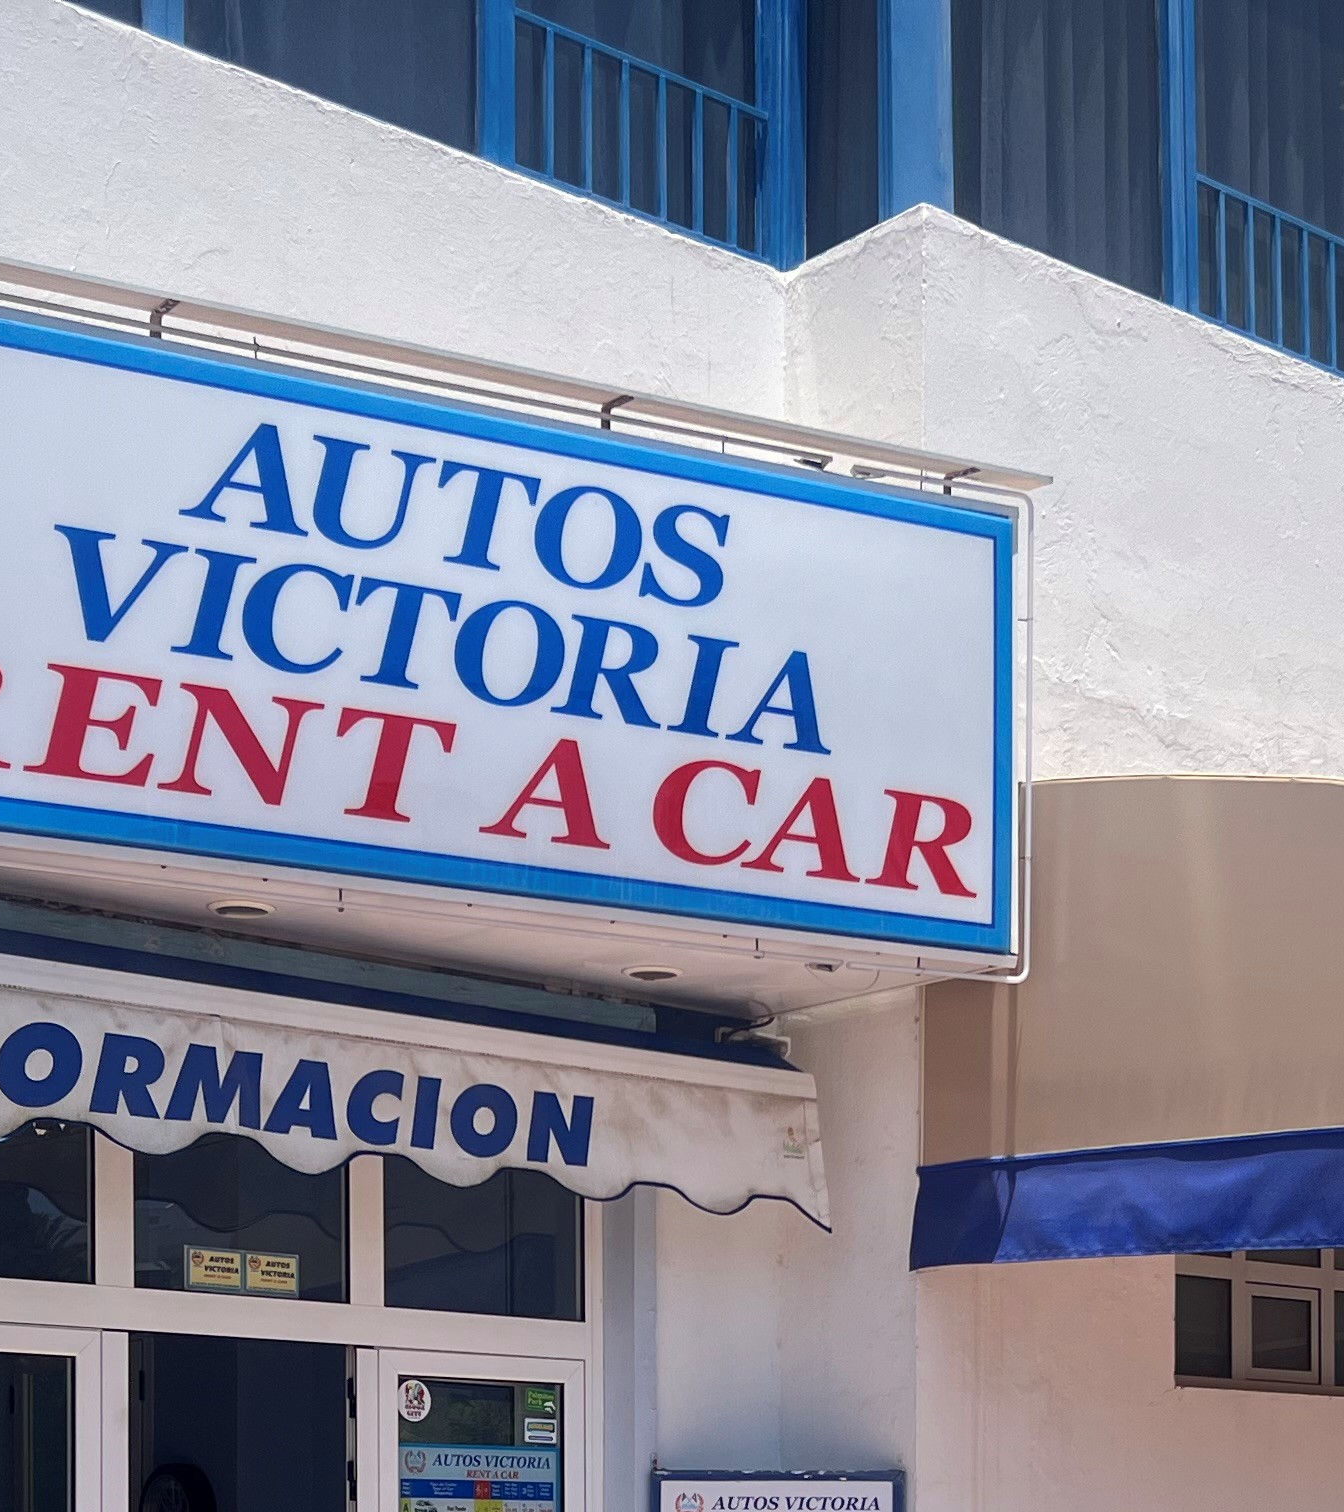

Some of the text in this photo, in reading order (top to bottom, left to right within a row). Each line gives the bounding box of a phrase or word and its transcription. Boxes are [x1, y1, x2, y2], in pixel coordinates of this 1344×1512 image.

[179, 423, 730, 607] AUTOS
[55, 524, 832, 757] VICTORIA
[479, 738, 611, 851] A
[653, 758, 979, 900] CAR
[209, 1256, 234, 1264] AUTOS
[266, 1261, 290, 1269] AUTOS
[204, 1265, 239, 1274] VICTORIA
[261, 1270, 295, 1279] VICTORIA
[432, 1453, 551, 1469] AUTOS VICTORIA
[466, 1470, 519, 1479] RENT A CAR
[711, 1496, 880, 1511] AUTOS VICTORIA
